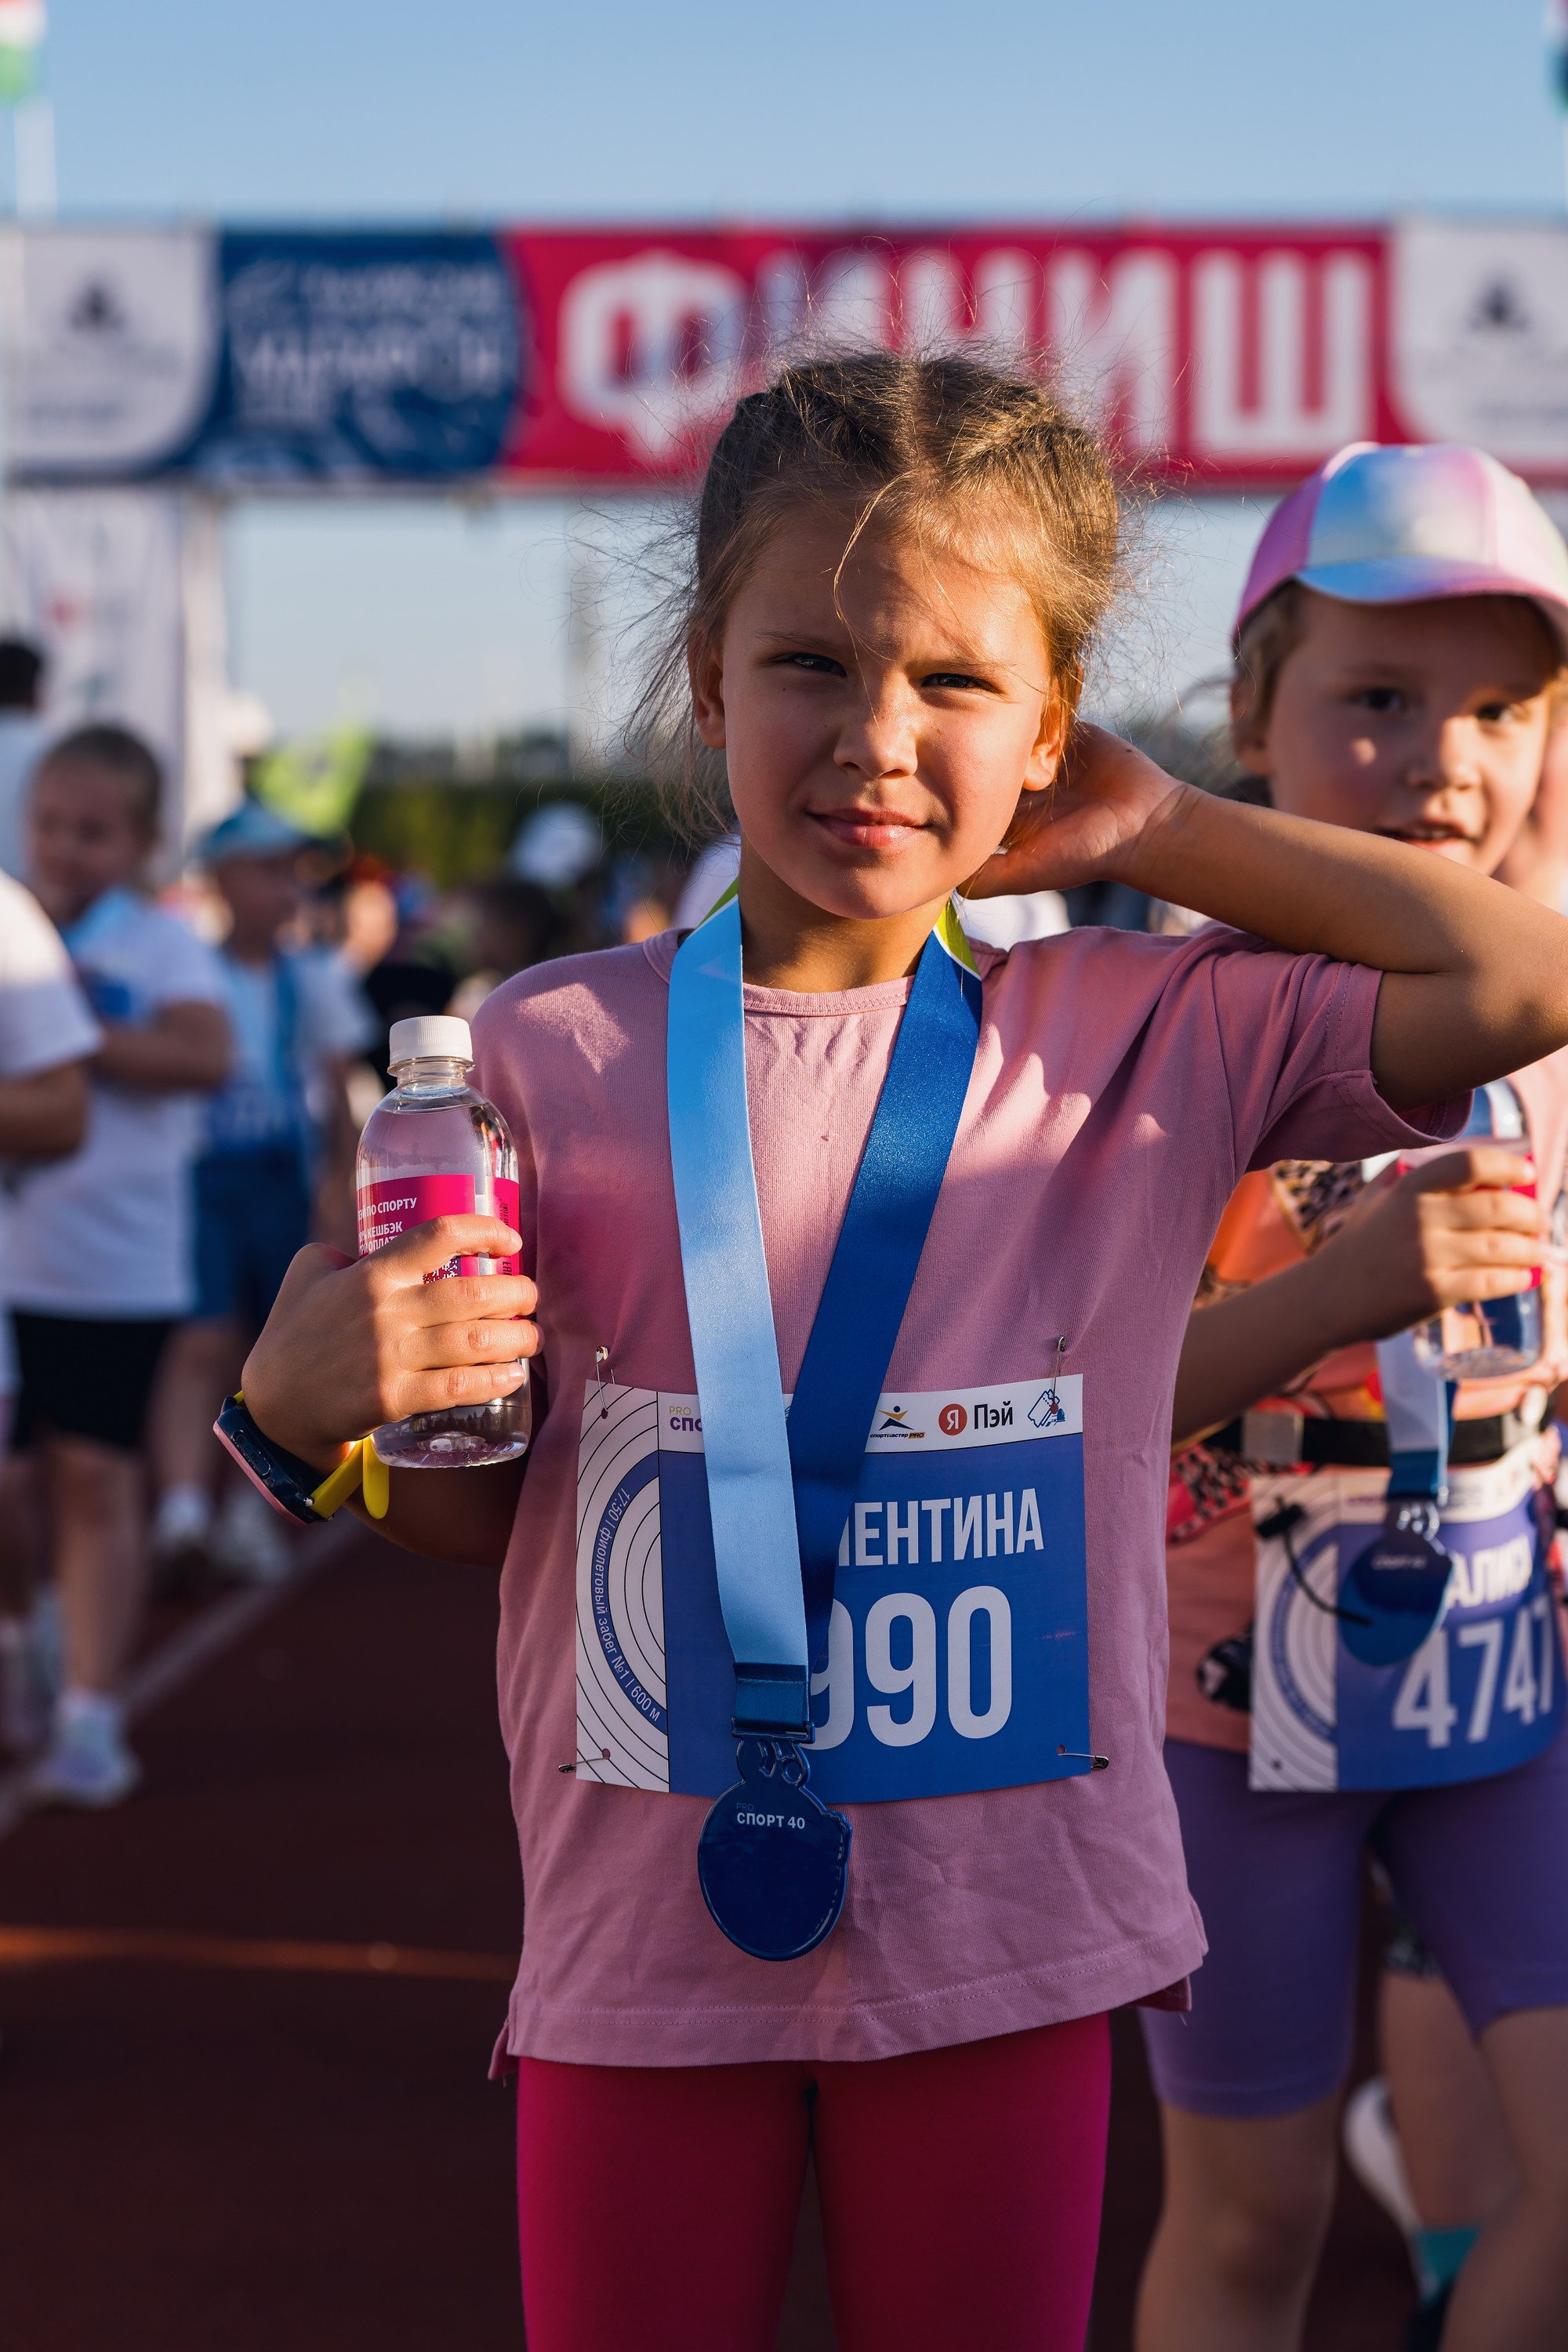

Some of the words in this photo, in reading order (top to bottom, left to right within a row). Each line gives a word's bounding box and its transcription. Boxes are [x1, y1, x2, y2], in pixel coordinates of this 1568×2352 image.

[366, 1204, 376, 1218] ПО
[377, 1197, 417, 1214] СПОРТУ
[367, 1221, 403, 1239] КЕШБЭК
[368, 1235, 398, 1252] ОПЛА
[669, 1406, 691, 1416] PRO
[946, 1409, 959, 1431] Я
[974, 1400, 1014, 1430] Пэй
[608, 1488, 630, 1522] 17:50
[594, 1526, 612, 1614] фиолетовый
[598, 1618, 617, 1653] забег
[612, 1655, 630, 1679] №1
[631, 1686, 652, 1711] 600
[736, 1802, 754, 1812] PRO
[737, 1812, 785, 1828] СПОРТ
[787, 1816, 806, 1829] 40
